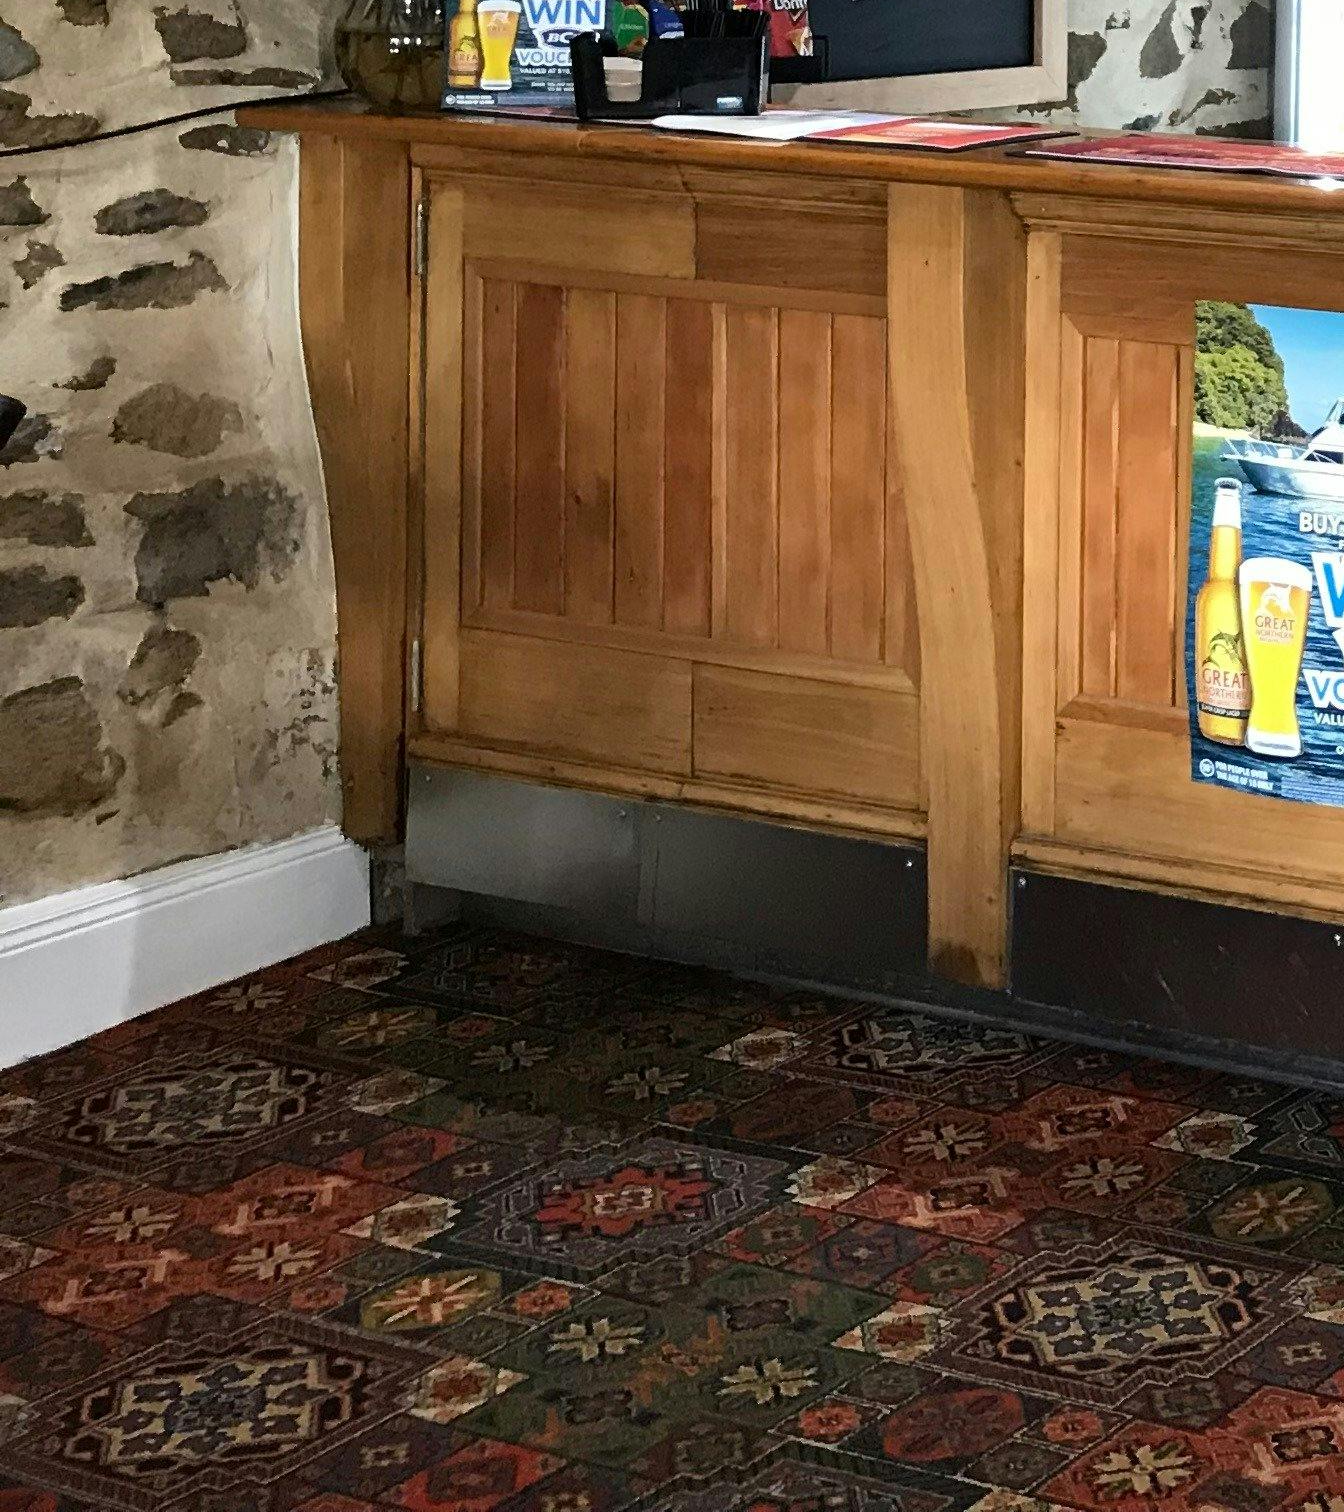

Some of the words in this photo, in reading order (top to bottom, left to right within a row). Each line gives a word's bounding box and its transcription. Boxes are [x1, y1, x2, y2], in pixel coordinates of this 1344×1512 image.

[527, 0, 600, 25] WIN
[546, 32, 572, 44] BC
[1300, 512, 1340, 534] BUY
[1255, 615, 1295, 631] GREAT
[1202, 668, 1248, 690] GREAT
